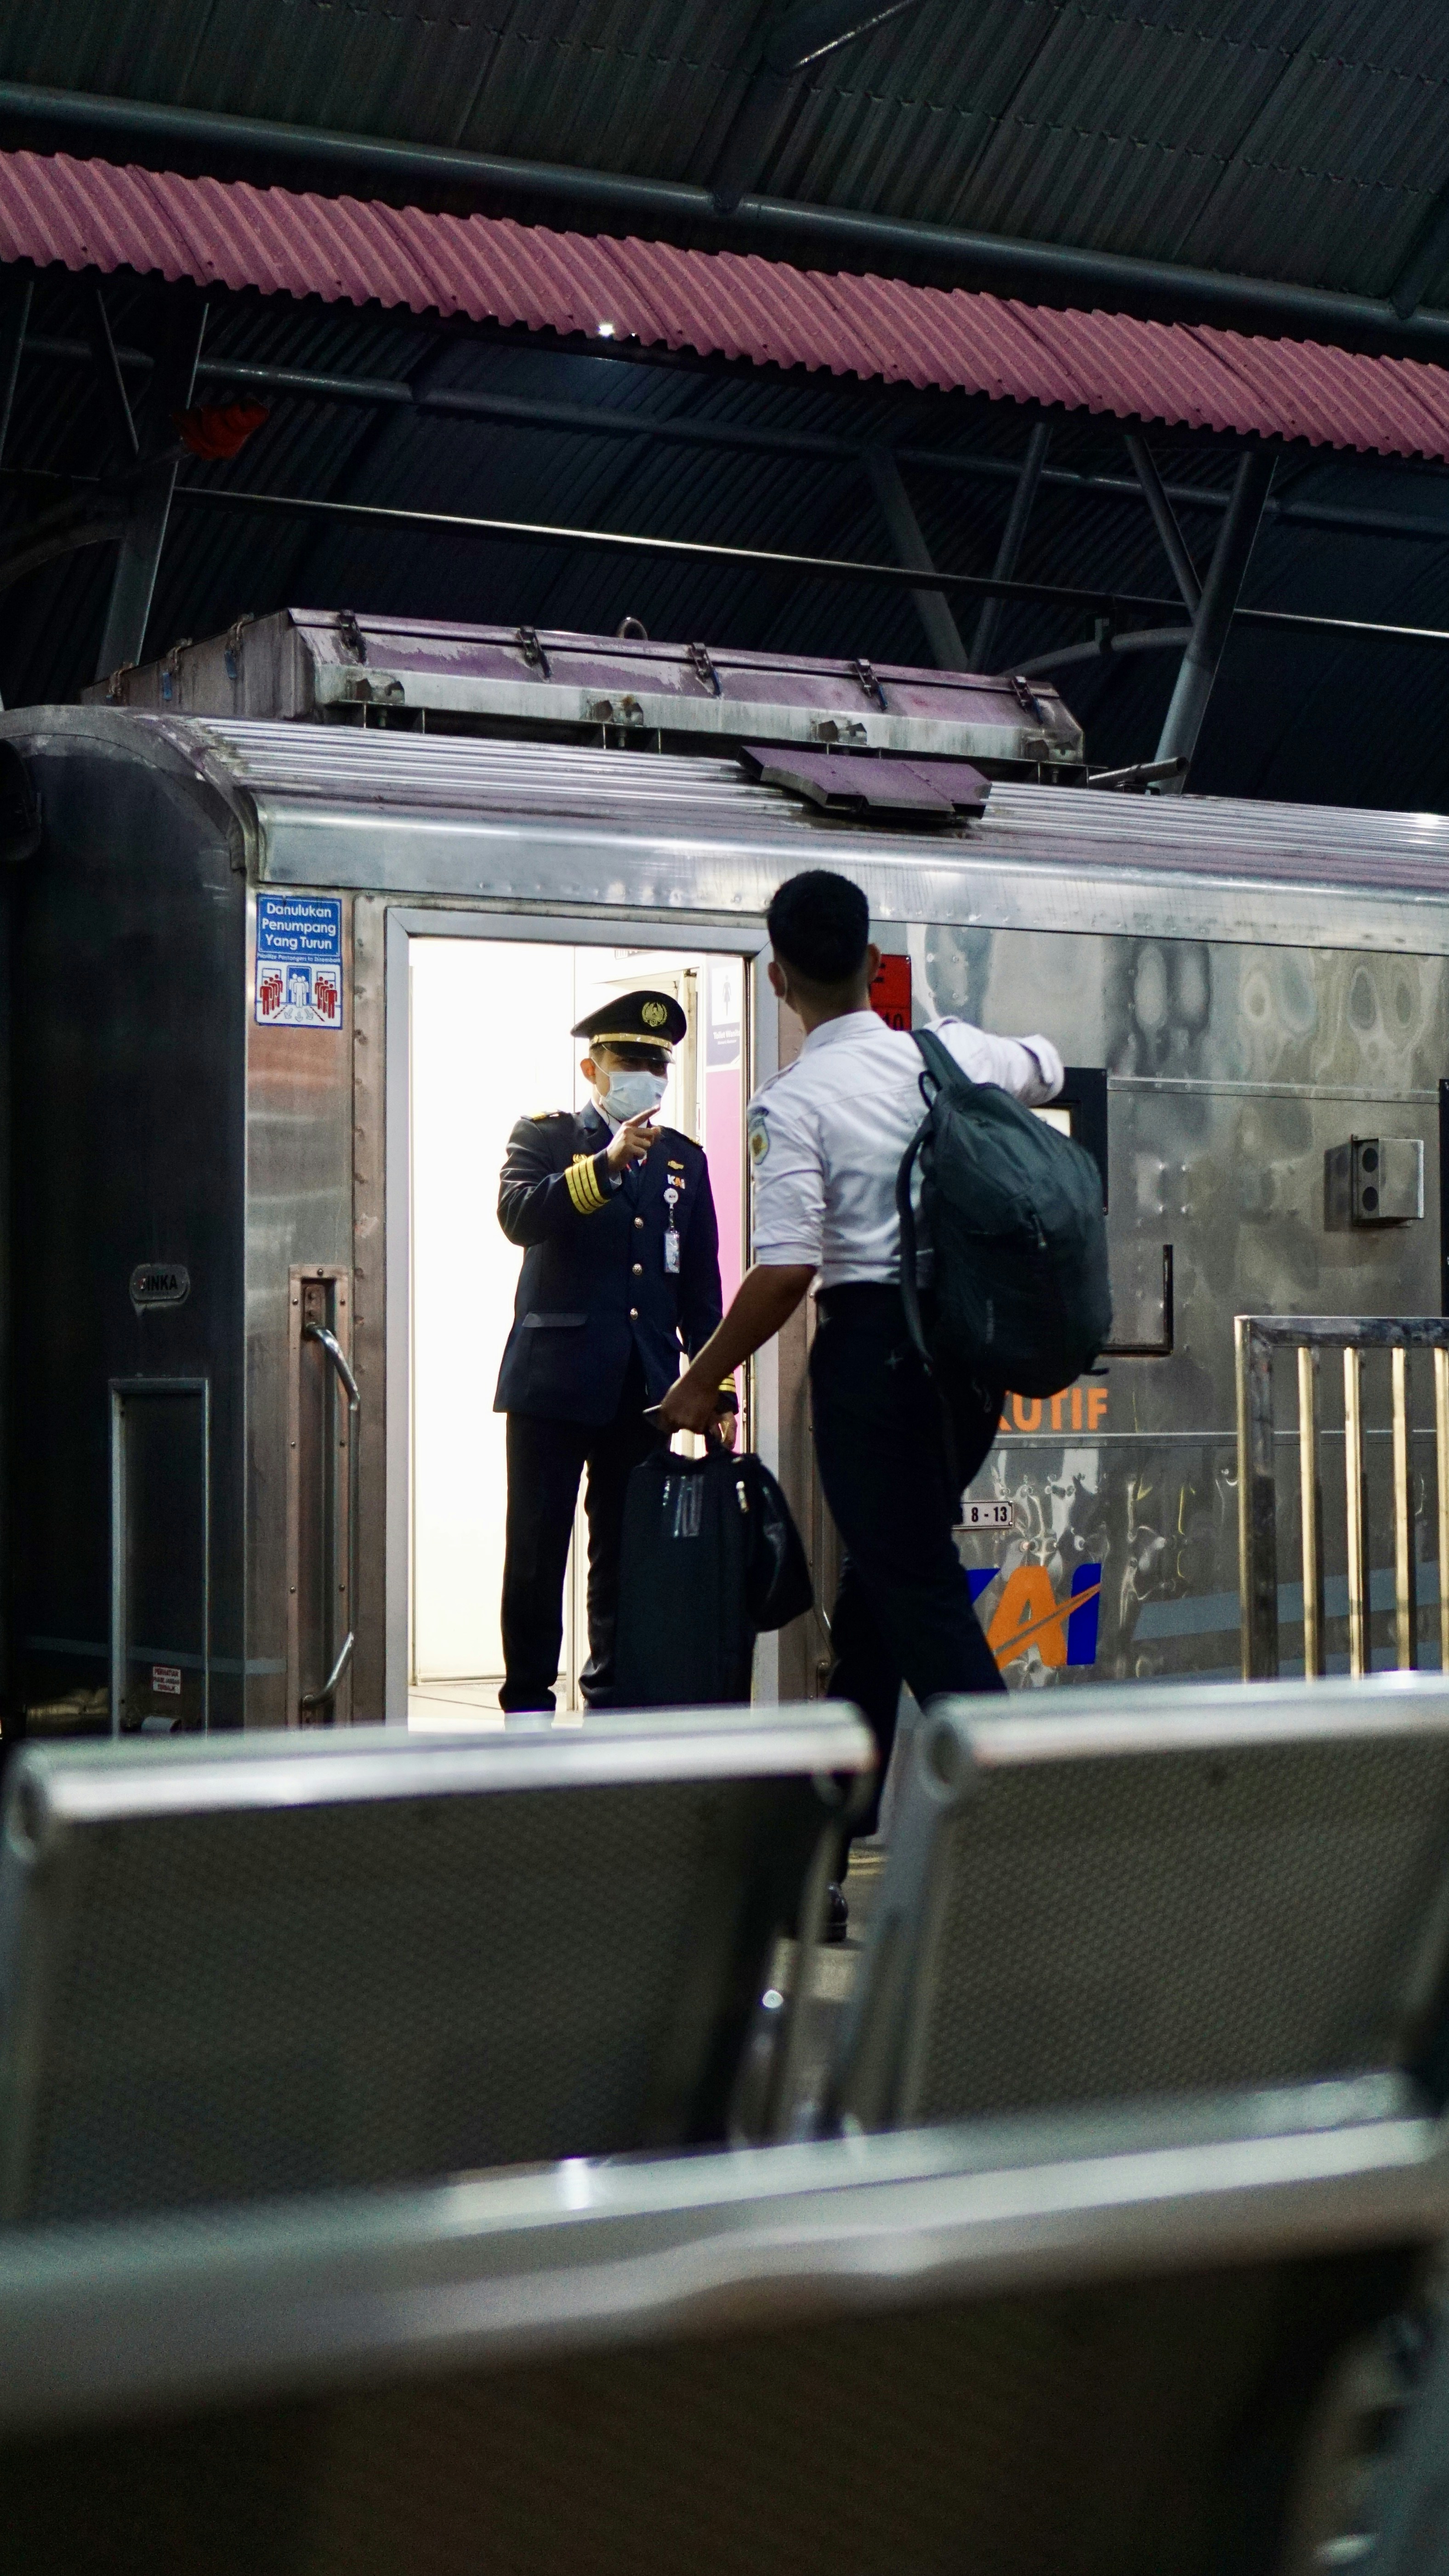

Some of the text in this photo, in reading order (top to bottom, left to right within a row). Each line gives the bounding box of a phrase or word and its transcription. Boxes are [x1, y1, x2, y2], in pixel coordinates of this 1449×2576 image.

[262, 918, 336, 936] Penumpang
[265, 934, 332, 950] Yang Turun
[713, 1031, 725, 1039] Toilet
[667, 1174, 685, 1189] KAI
[972, 1507, 978, 1522] 8
[993, 1506, 1007, 1522] 13
[967, 1563, 1101, 1667] AI
